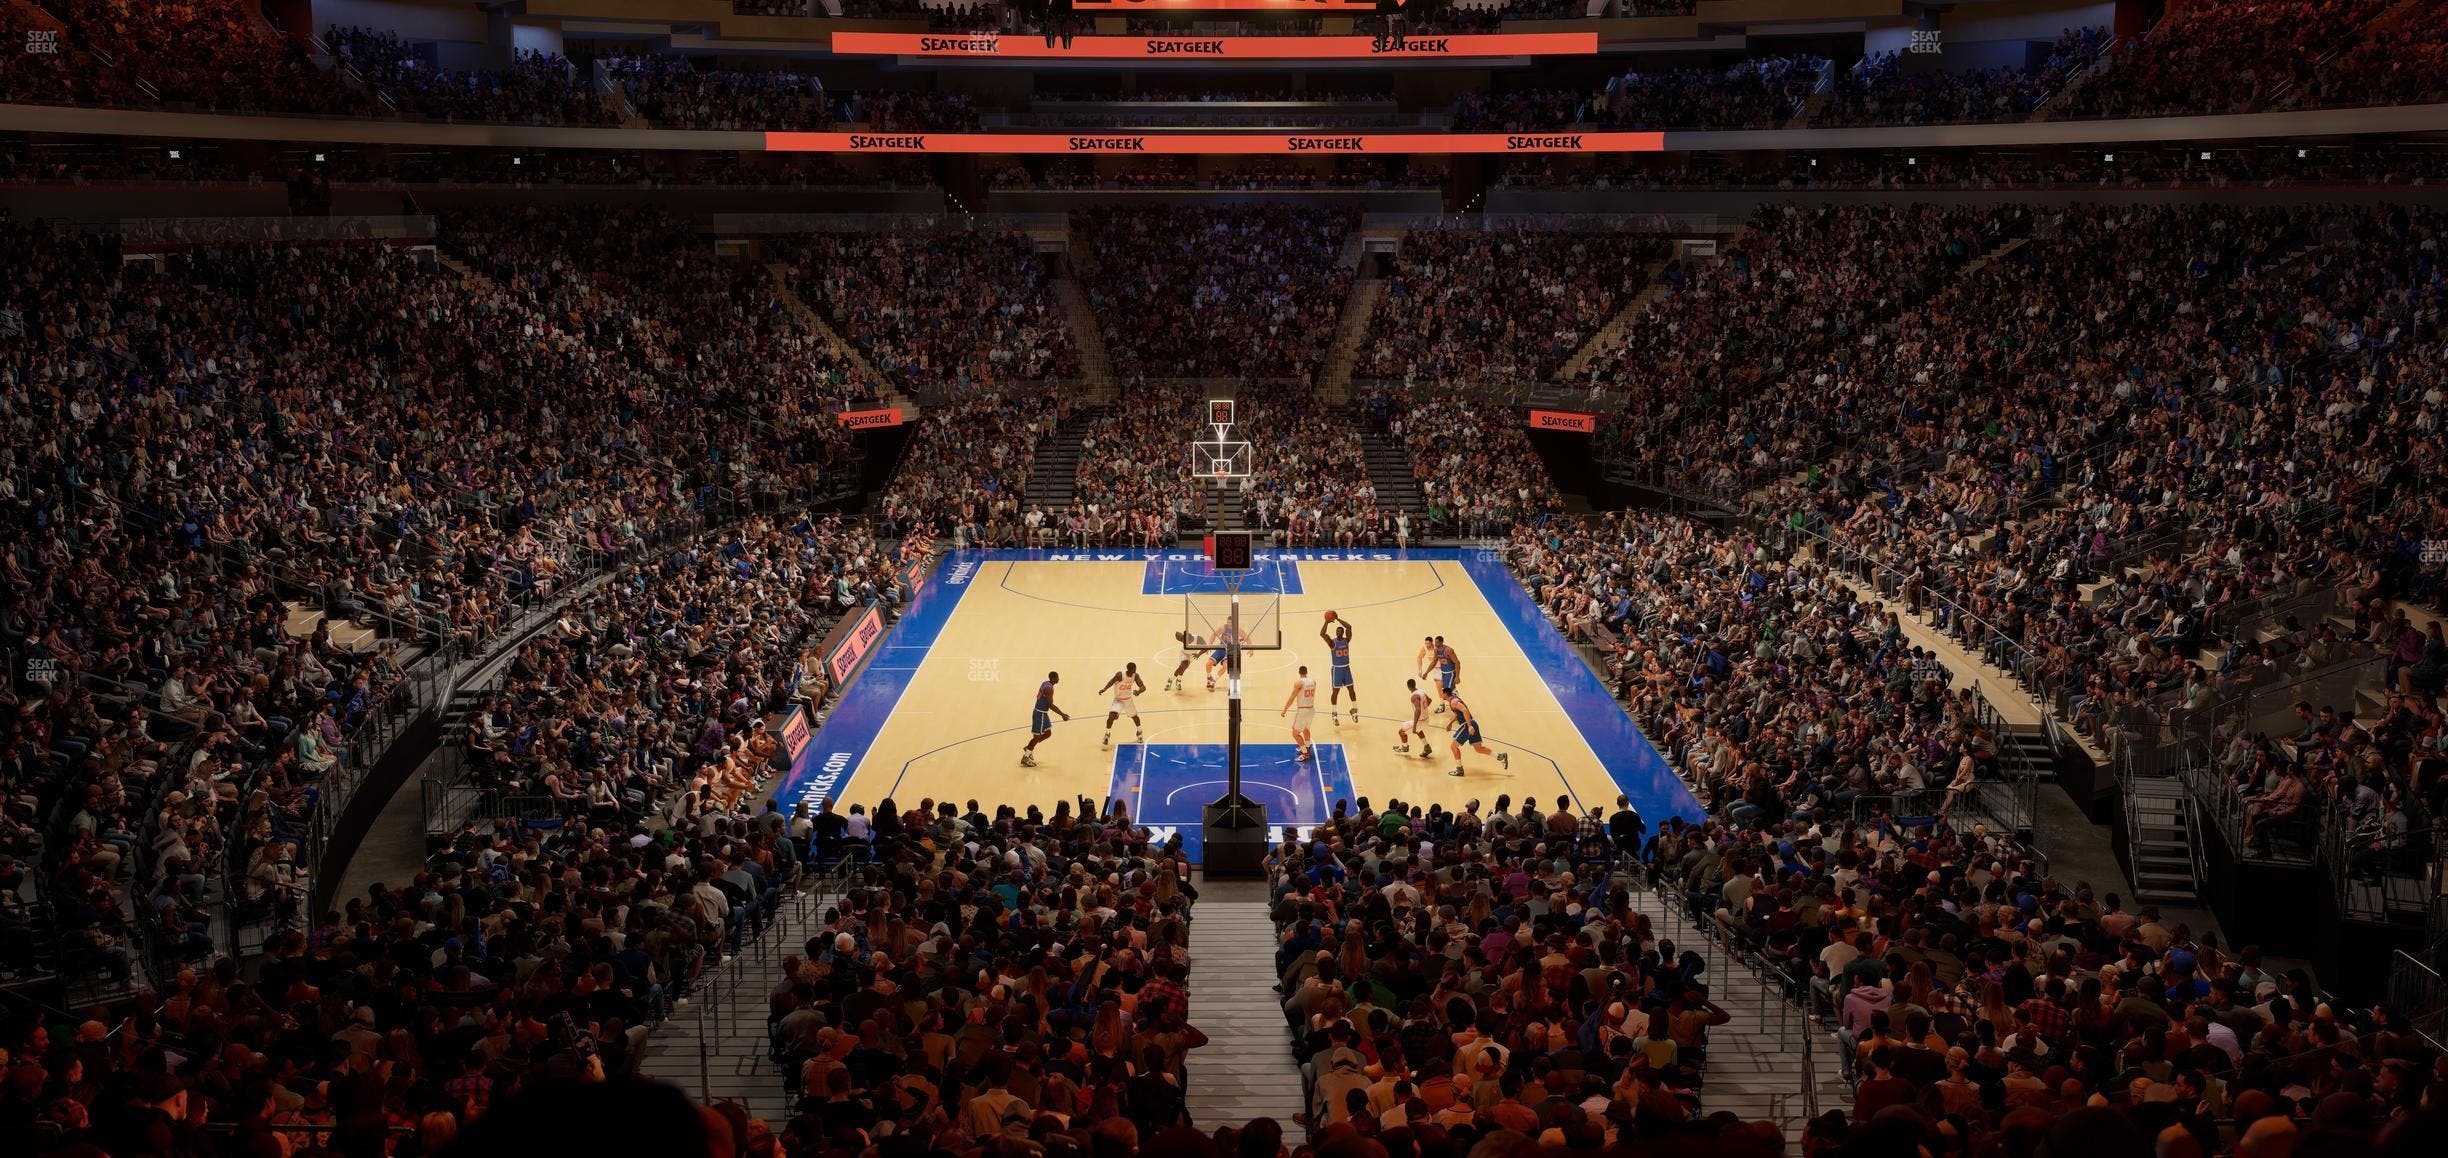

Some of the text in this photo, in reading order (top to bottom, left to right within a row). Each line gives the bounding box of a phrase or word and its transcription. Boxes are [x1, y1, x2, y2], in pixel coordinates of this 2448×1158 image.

[921, 38, 999, 52] SEATGEEK
[1147, 40, 1224, 54] SEATGEEK
[850, 135, 925, 149] SEATGEEK
[1069, 137, 1144, 151] SEATGEEK
[1288, 137, 1363, 151] SEATGEEK
[1507, 136, 1582, 150] SEATGEEK
[849, 413, 891, 427] SEATGEEK
[1541, 415, 1584, 430] SEATGEEK
